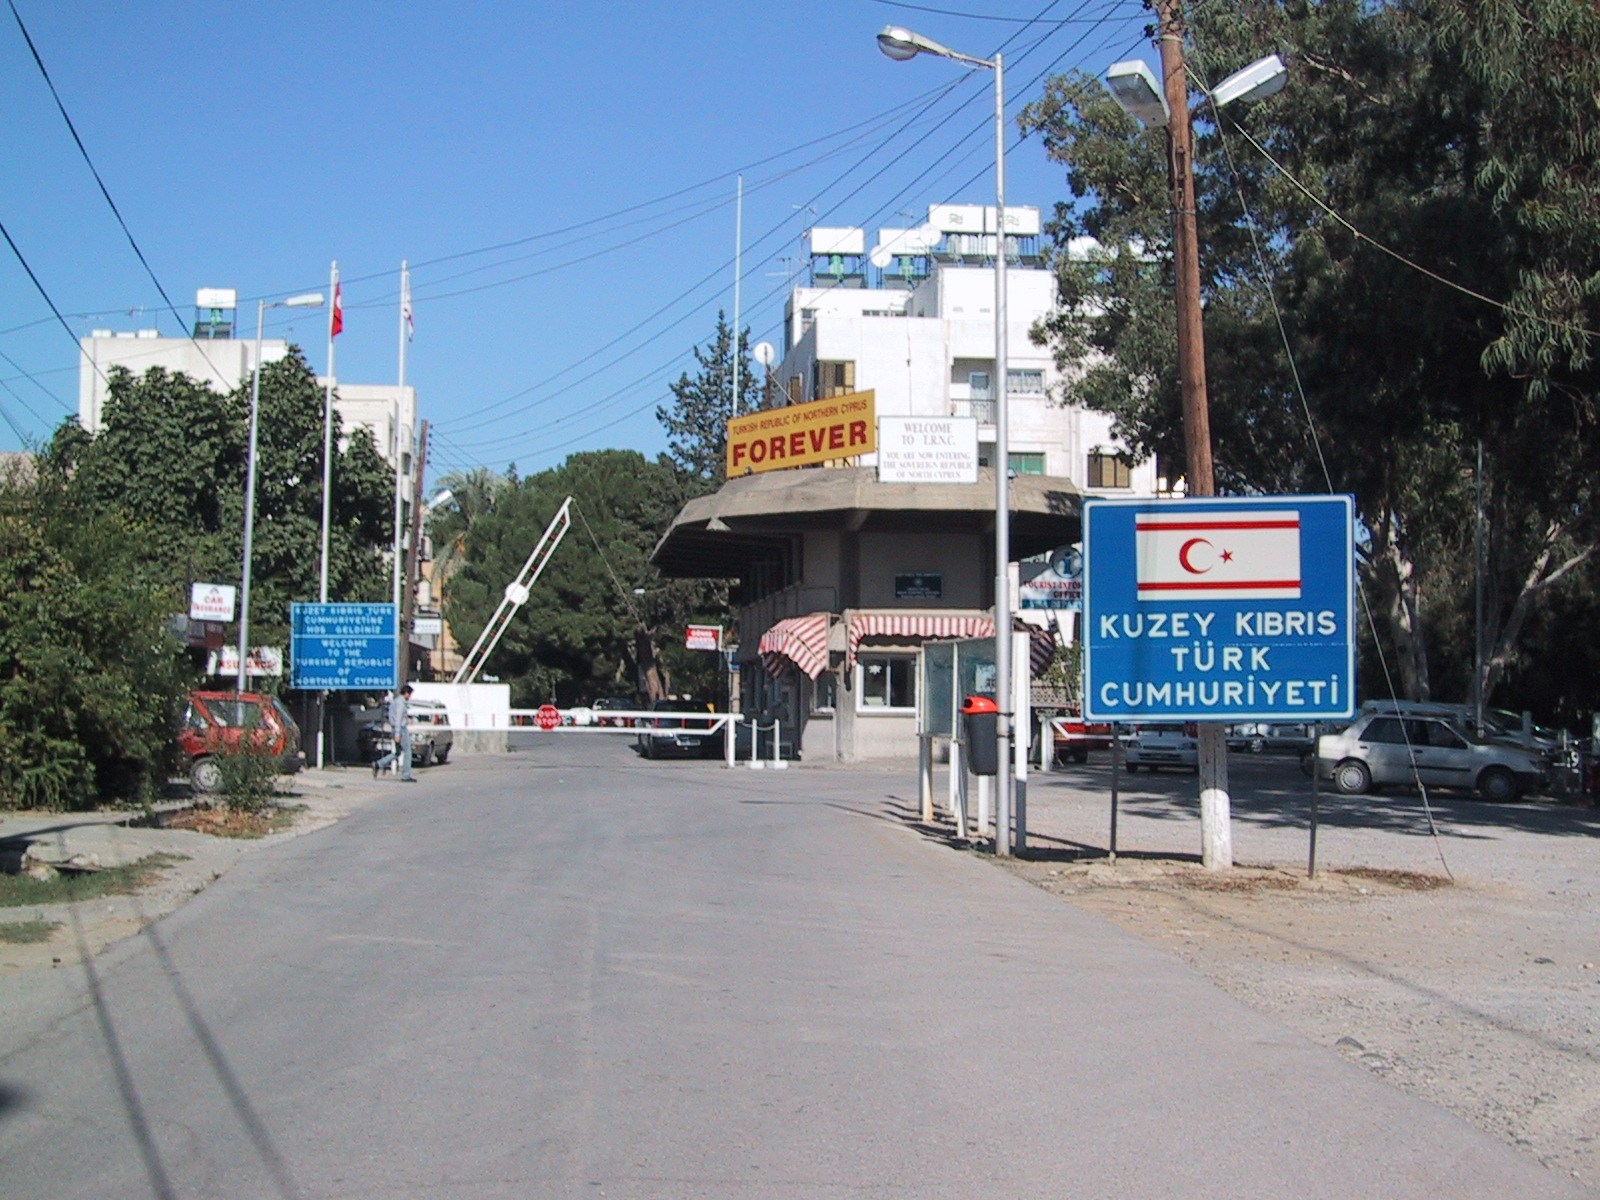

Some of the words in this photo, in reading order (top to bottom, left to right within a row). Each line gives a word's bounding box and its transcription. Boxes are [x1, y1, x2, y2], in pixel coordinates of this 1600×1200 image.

[733, 423, 758, 435] TURKISH
[761, 415, 790, 430] REPUBLIC
[792, 413, 801, 424] OF
[803, 406, 838, 421] NORTHERN
[841, 400, 867, 413] CYPRUS
[904, 422, 952, 433] WELCOME
[732, 420, 867, 467] FOREVER
[902, 435, 914, 445] TO
[886, 452, 899, 460] YOU
[903, 452, 915, 460] ARE
[918, 452, 934, 460] NOW
[936, 452, 970, 460] ENTERING
[883, 461, 896, 469] THE
[940, 461, 975, 469] REPUBLIC
[203, 596, 224, 604] CAR
[330, 606, 363, 615] KIBRIS
[1100, 612, 1215, 639] KUZEY
[1235, 611, 1337, 637] KIBRIS
[321, 639, 368, 648] WELCOME
[327, 649, 340, 657] TO
[343, 649, 361, 657] THE
[1171, 641, 1271, 672] TÜRK
[344, 658, 392, 667] REPUBLIC
[337, 667, 350, 676] OF
[354, 677, 392, 686] CYPRUS
[1100, 674, 1338, 707] CUMHURİYETİ
